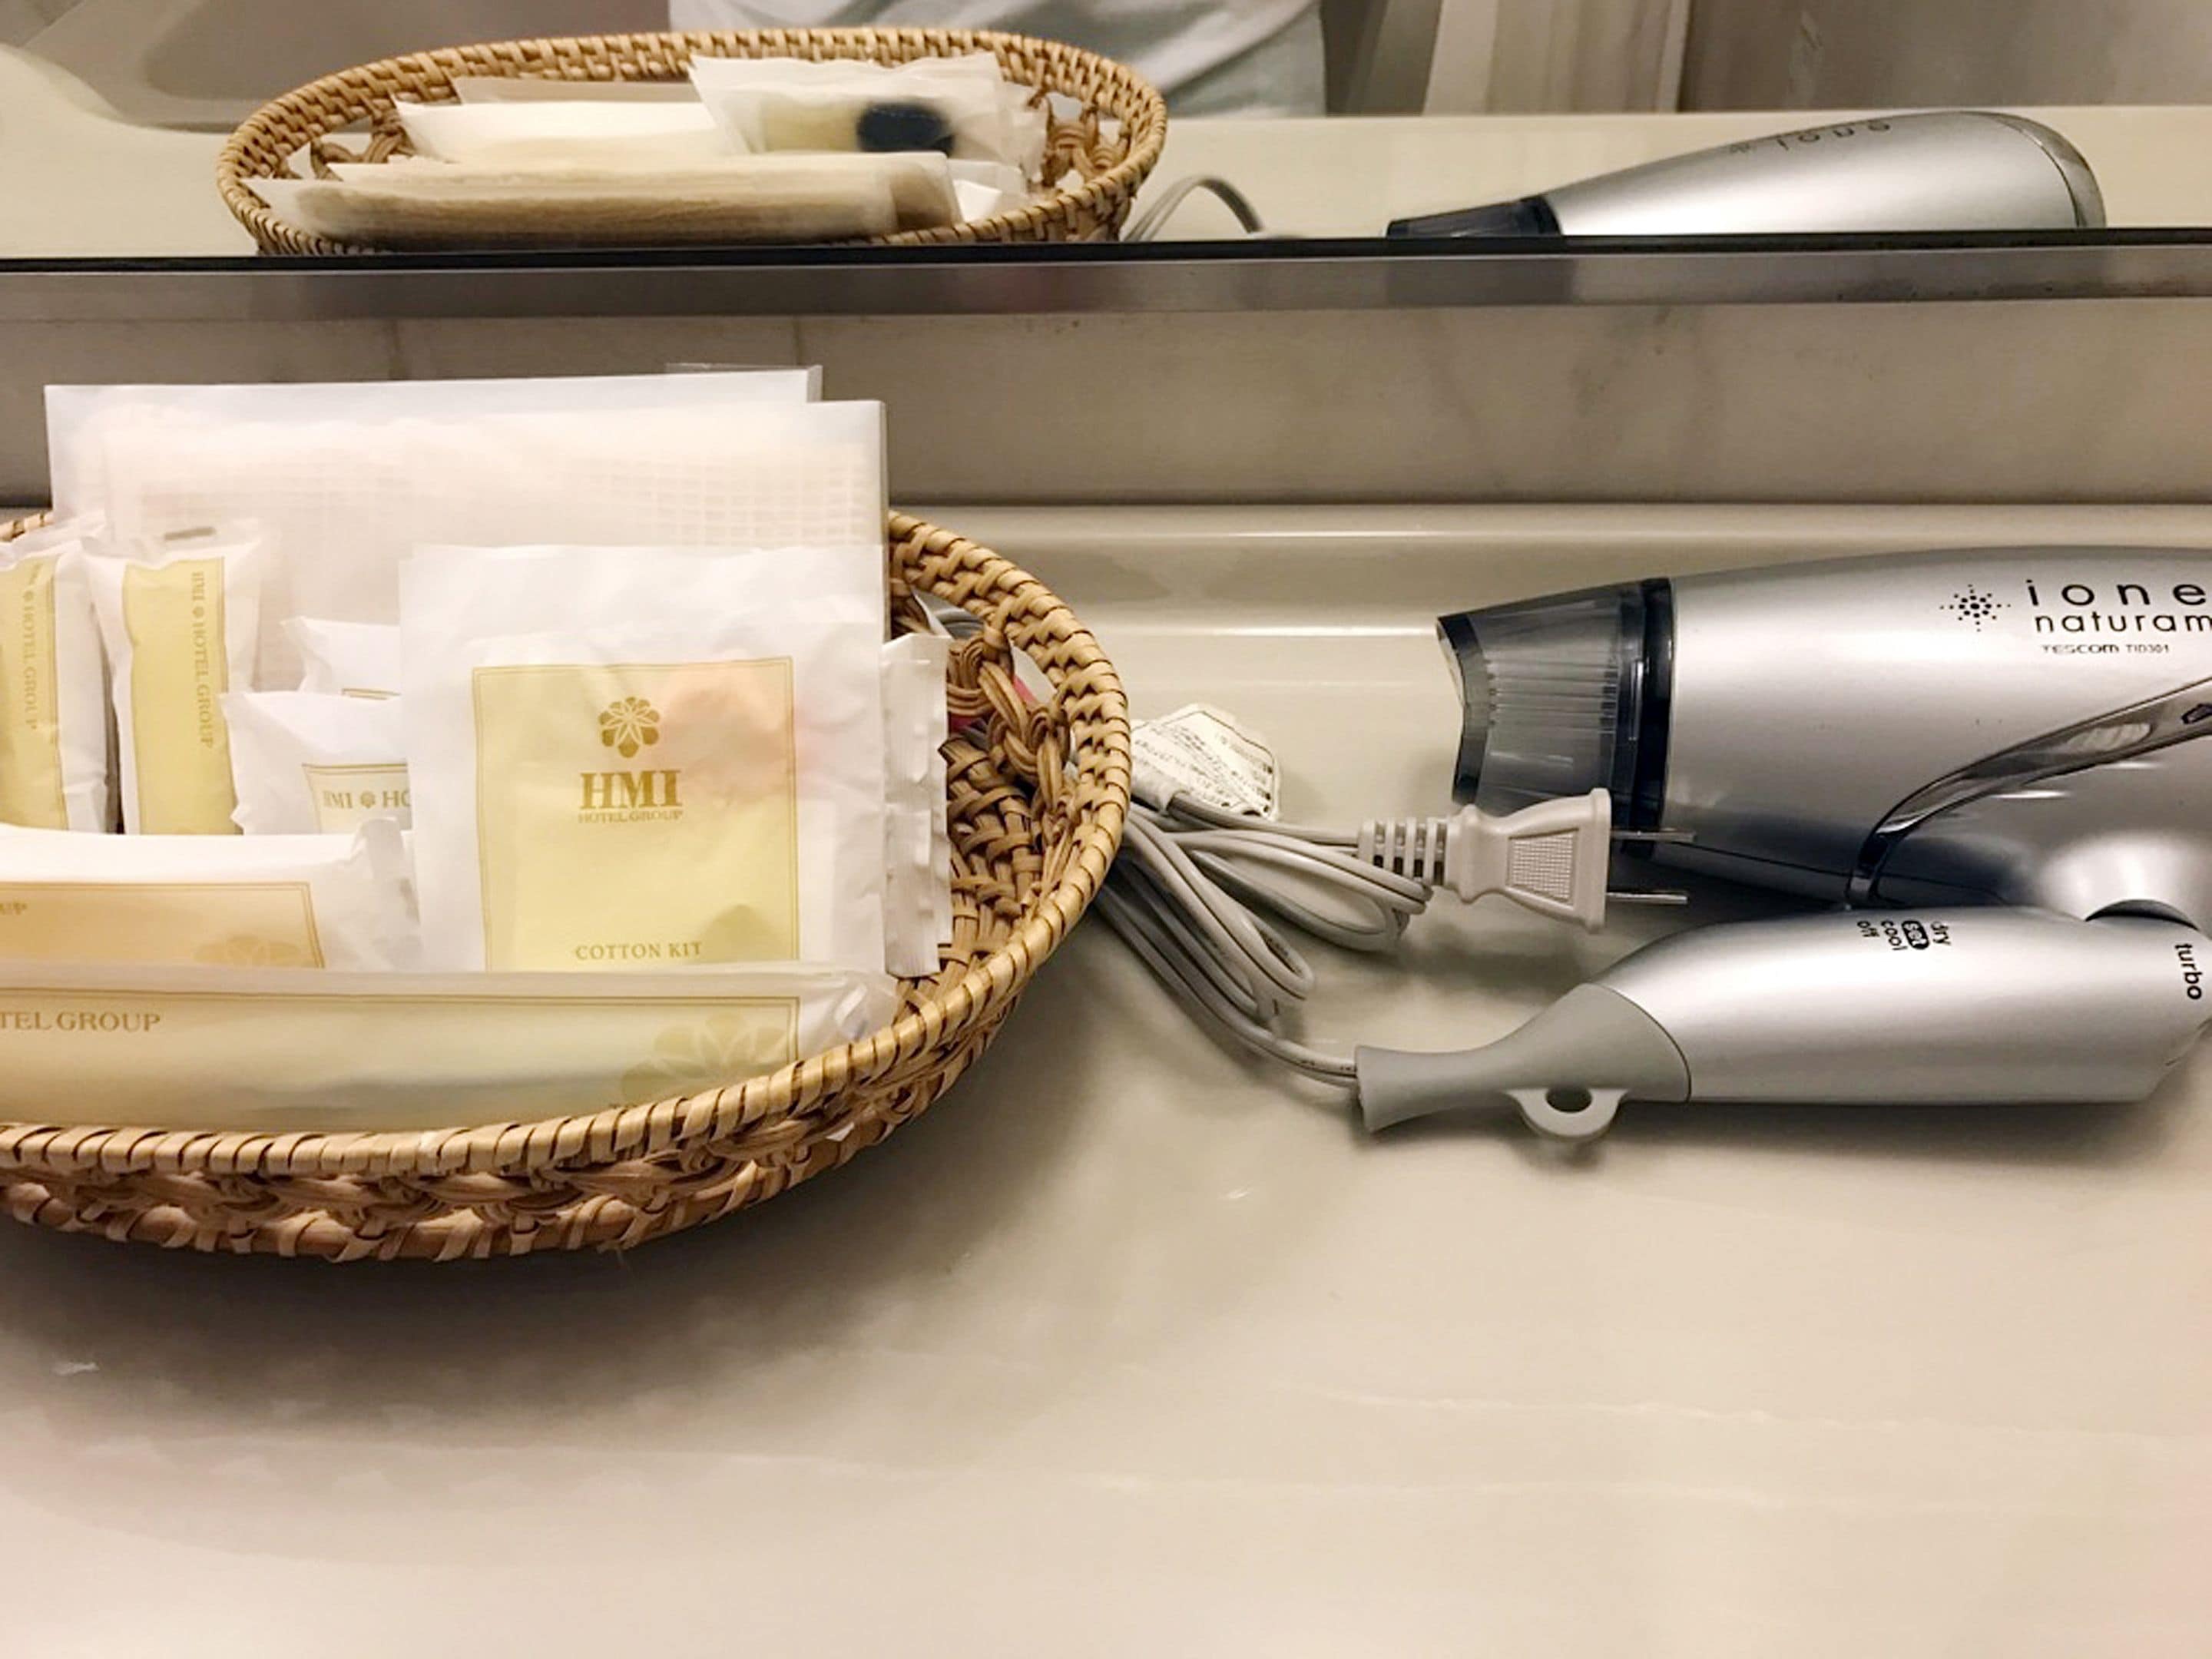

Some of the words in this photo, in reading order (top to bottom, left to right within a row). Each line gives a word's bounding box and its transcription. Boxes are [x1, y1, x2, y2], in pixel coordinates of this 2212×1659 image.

[2025, 578, 2207, 606] ione
[192, 622, 209, 682] HOTEL
[197, 684, 214, 749] GROUP
[580, 770, 683, 809] HMI
[578, 810, 628, 823] HOTEL
[629, 810, 684, 822] GROUP
[1880, 921, 1908, 950] cool
[573, 943, 661, 960] COTTON
[669, 942, 702, 959] KIT
[2174, 943, 2203, 1000] turbo
[56, 1011, 161, 1031] GROUP
